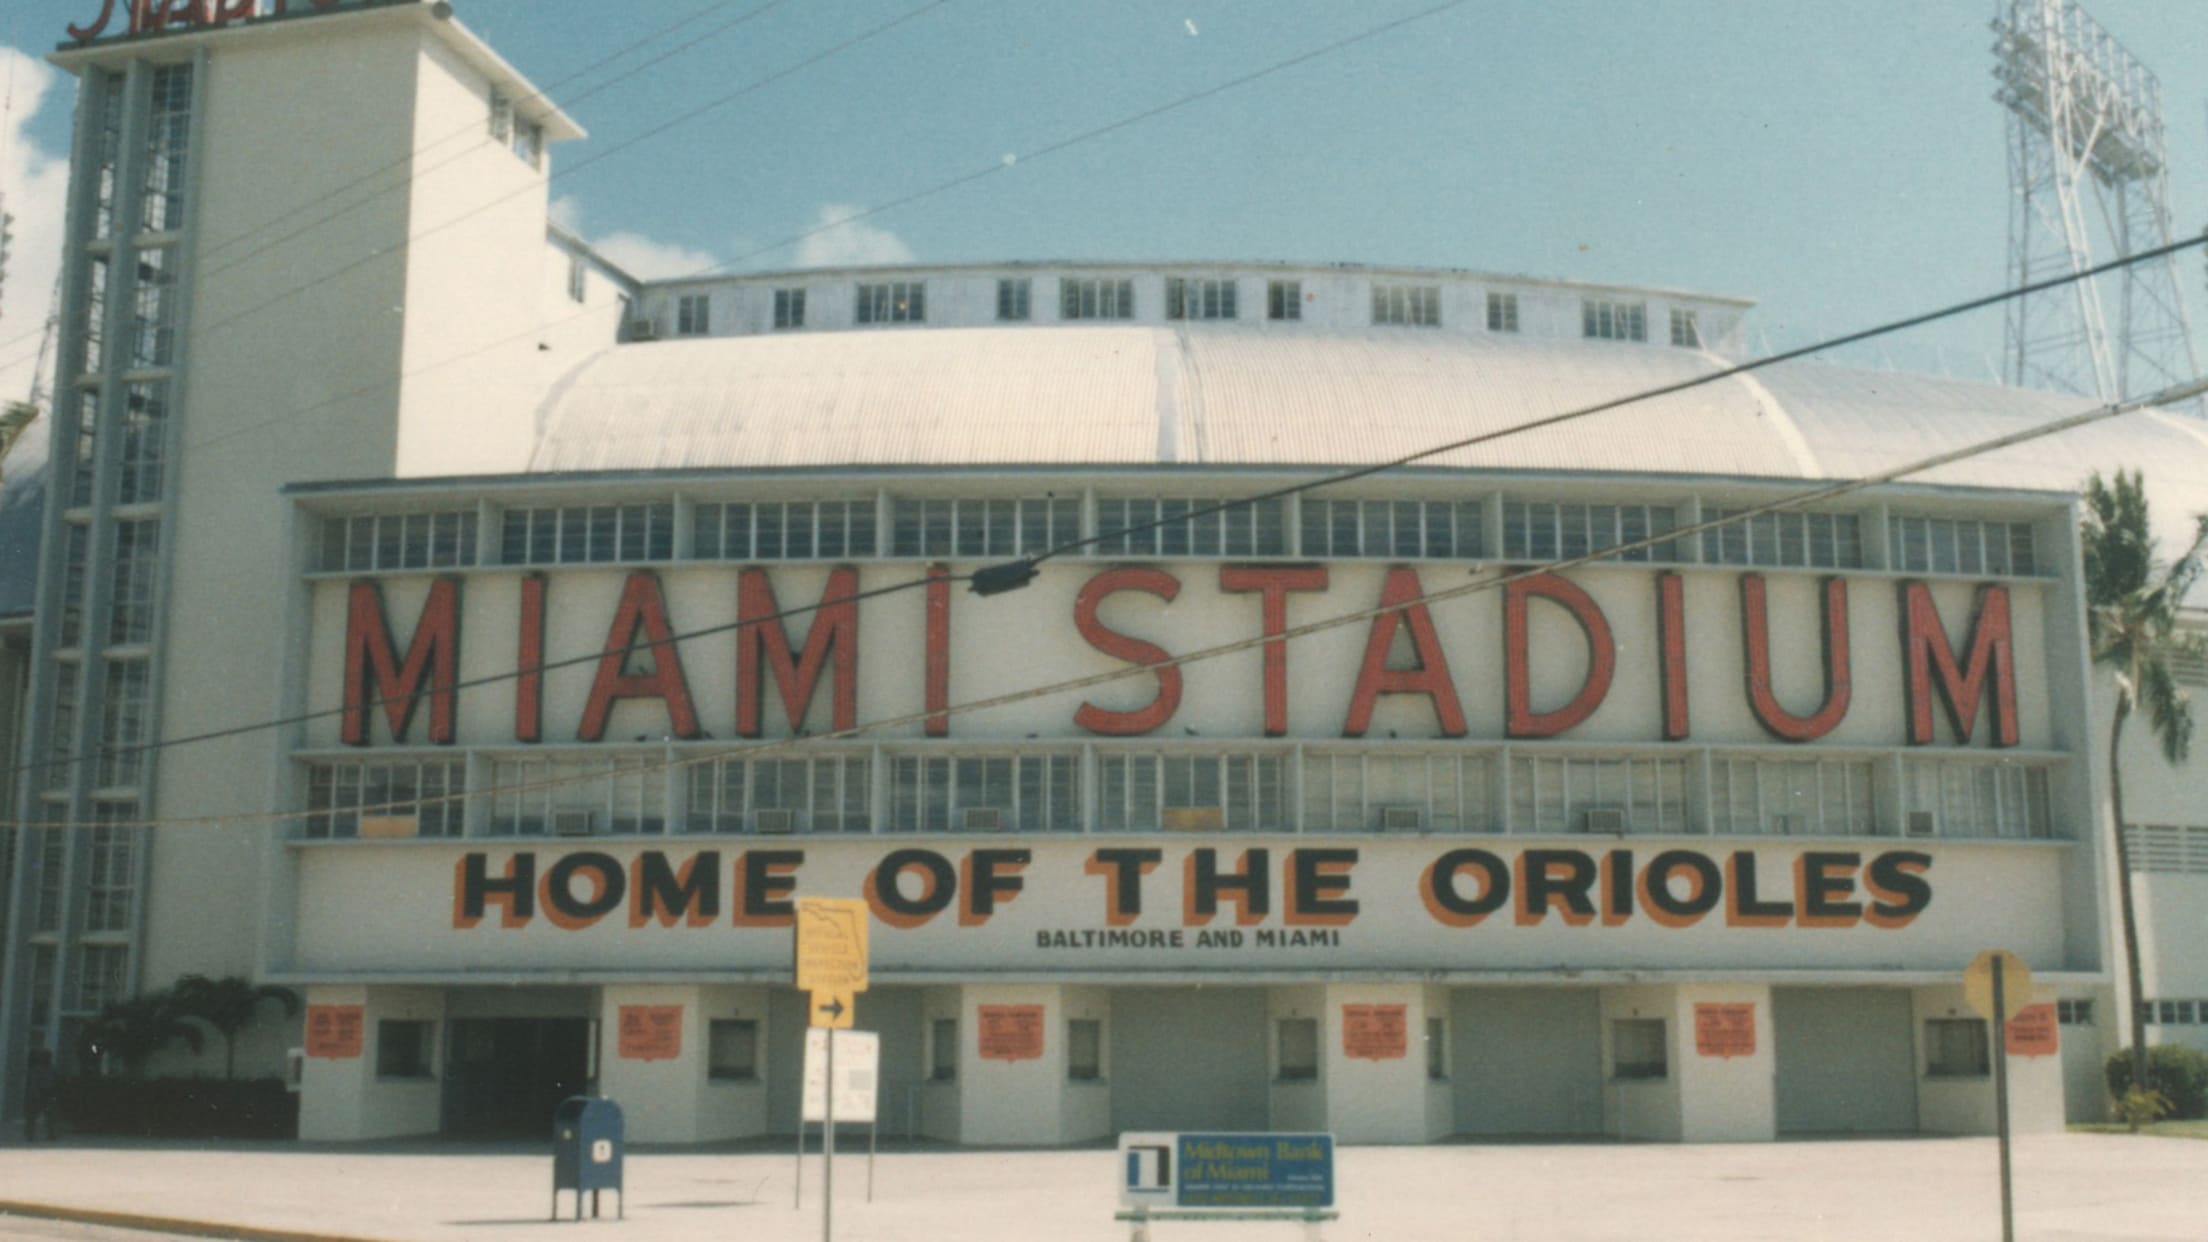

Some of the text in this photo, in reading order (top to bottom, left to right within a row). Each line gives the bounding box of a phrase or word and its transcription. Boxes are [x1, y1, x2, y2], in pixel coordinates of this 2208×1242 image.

[341, 563, 2019, 746] MIAMI STADIUM
[453, 848, 1933, 930] HOME OF THE ORIOLES
[1037, 930, 1340, 948] BALTIMORE AND MIAMI
[1278, 1142, 1323, 1160] Bank
[1184, 1163, 1204, 1180] of
[1208, 1163, 1270, 1180] Miami
